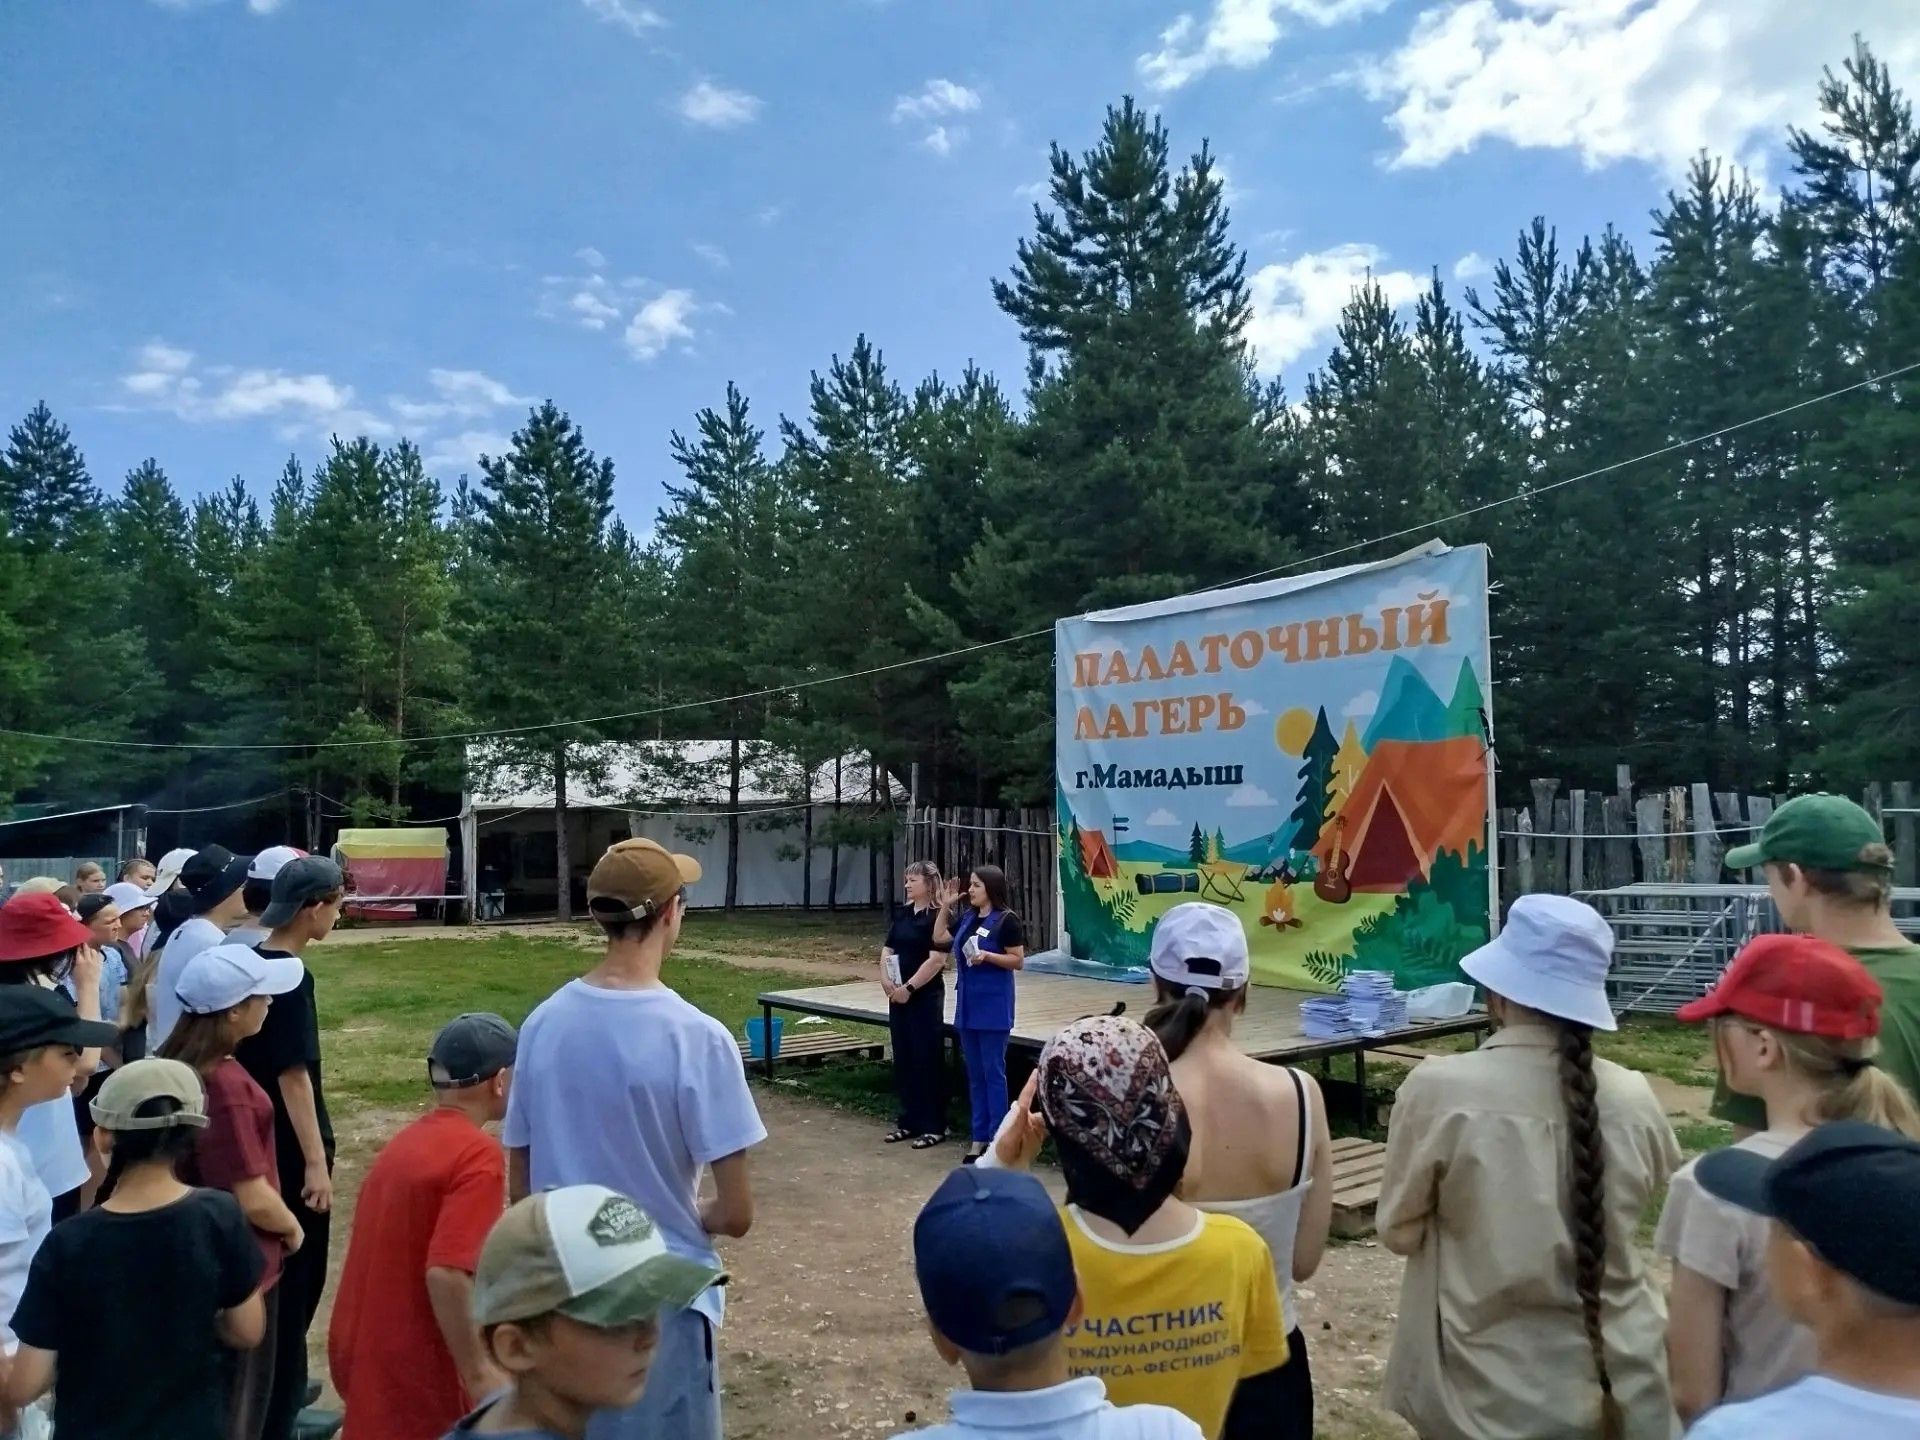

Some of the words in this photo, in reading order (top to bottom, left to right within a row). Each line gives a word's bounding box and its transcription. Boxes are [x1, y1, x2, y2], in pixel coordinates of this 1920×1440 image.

[1072, 590, 1451, 688] ПАЛАТОЧНЫЙ
[1074, 693, 1246, 741] ЛАГЕРЬ
[1075, 763, 1244, 790] г.Мамадыш
[1067, 1328, 1230, 1360] ЕЖДУНАРОДНОГО
